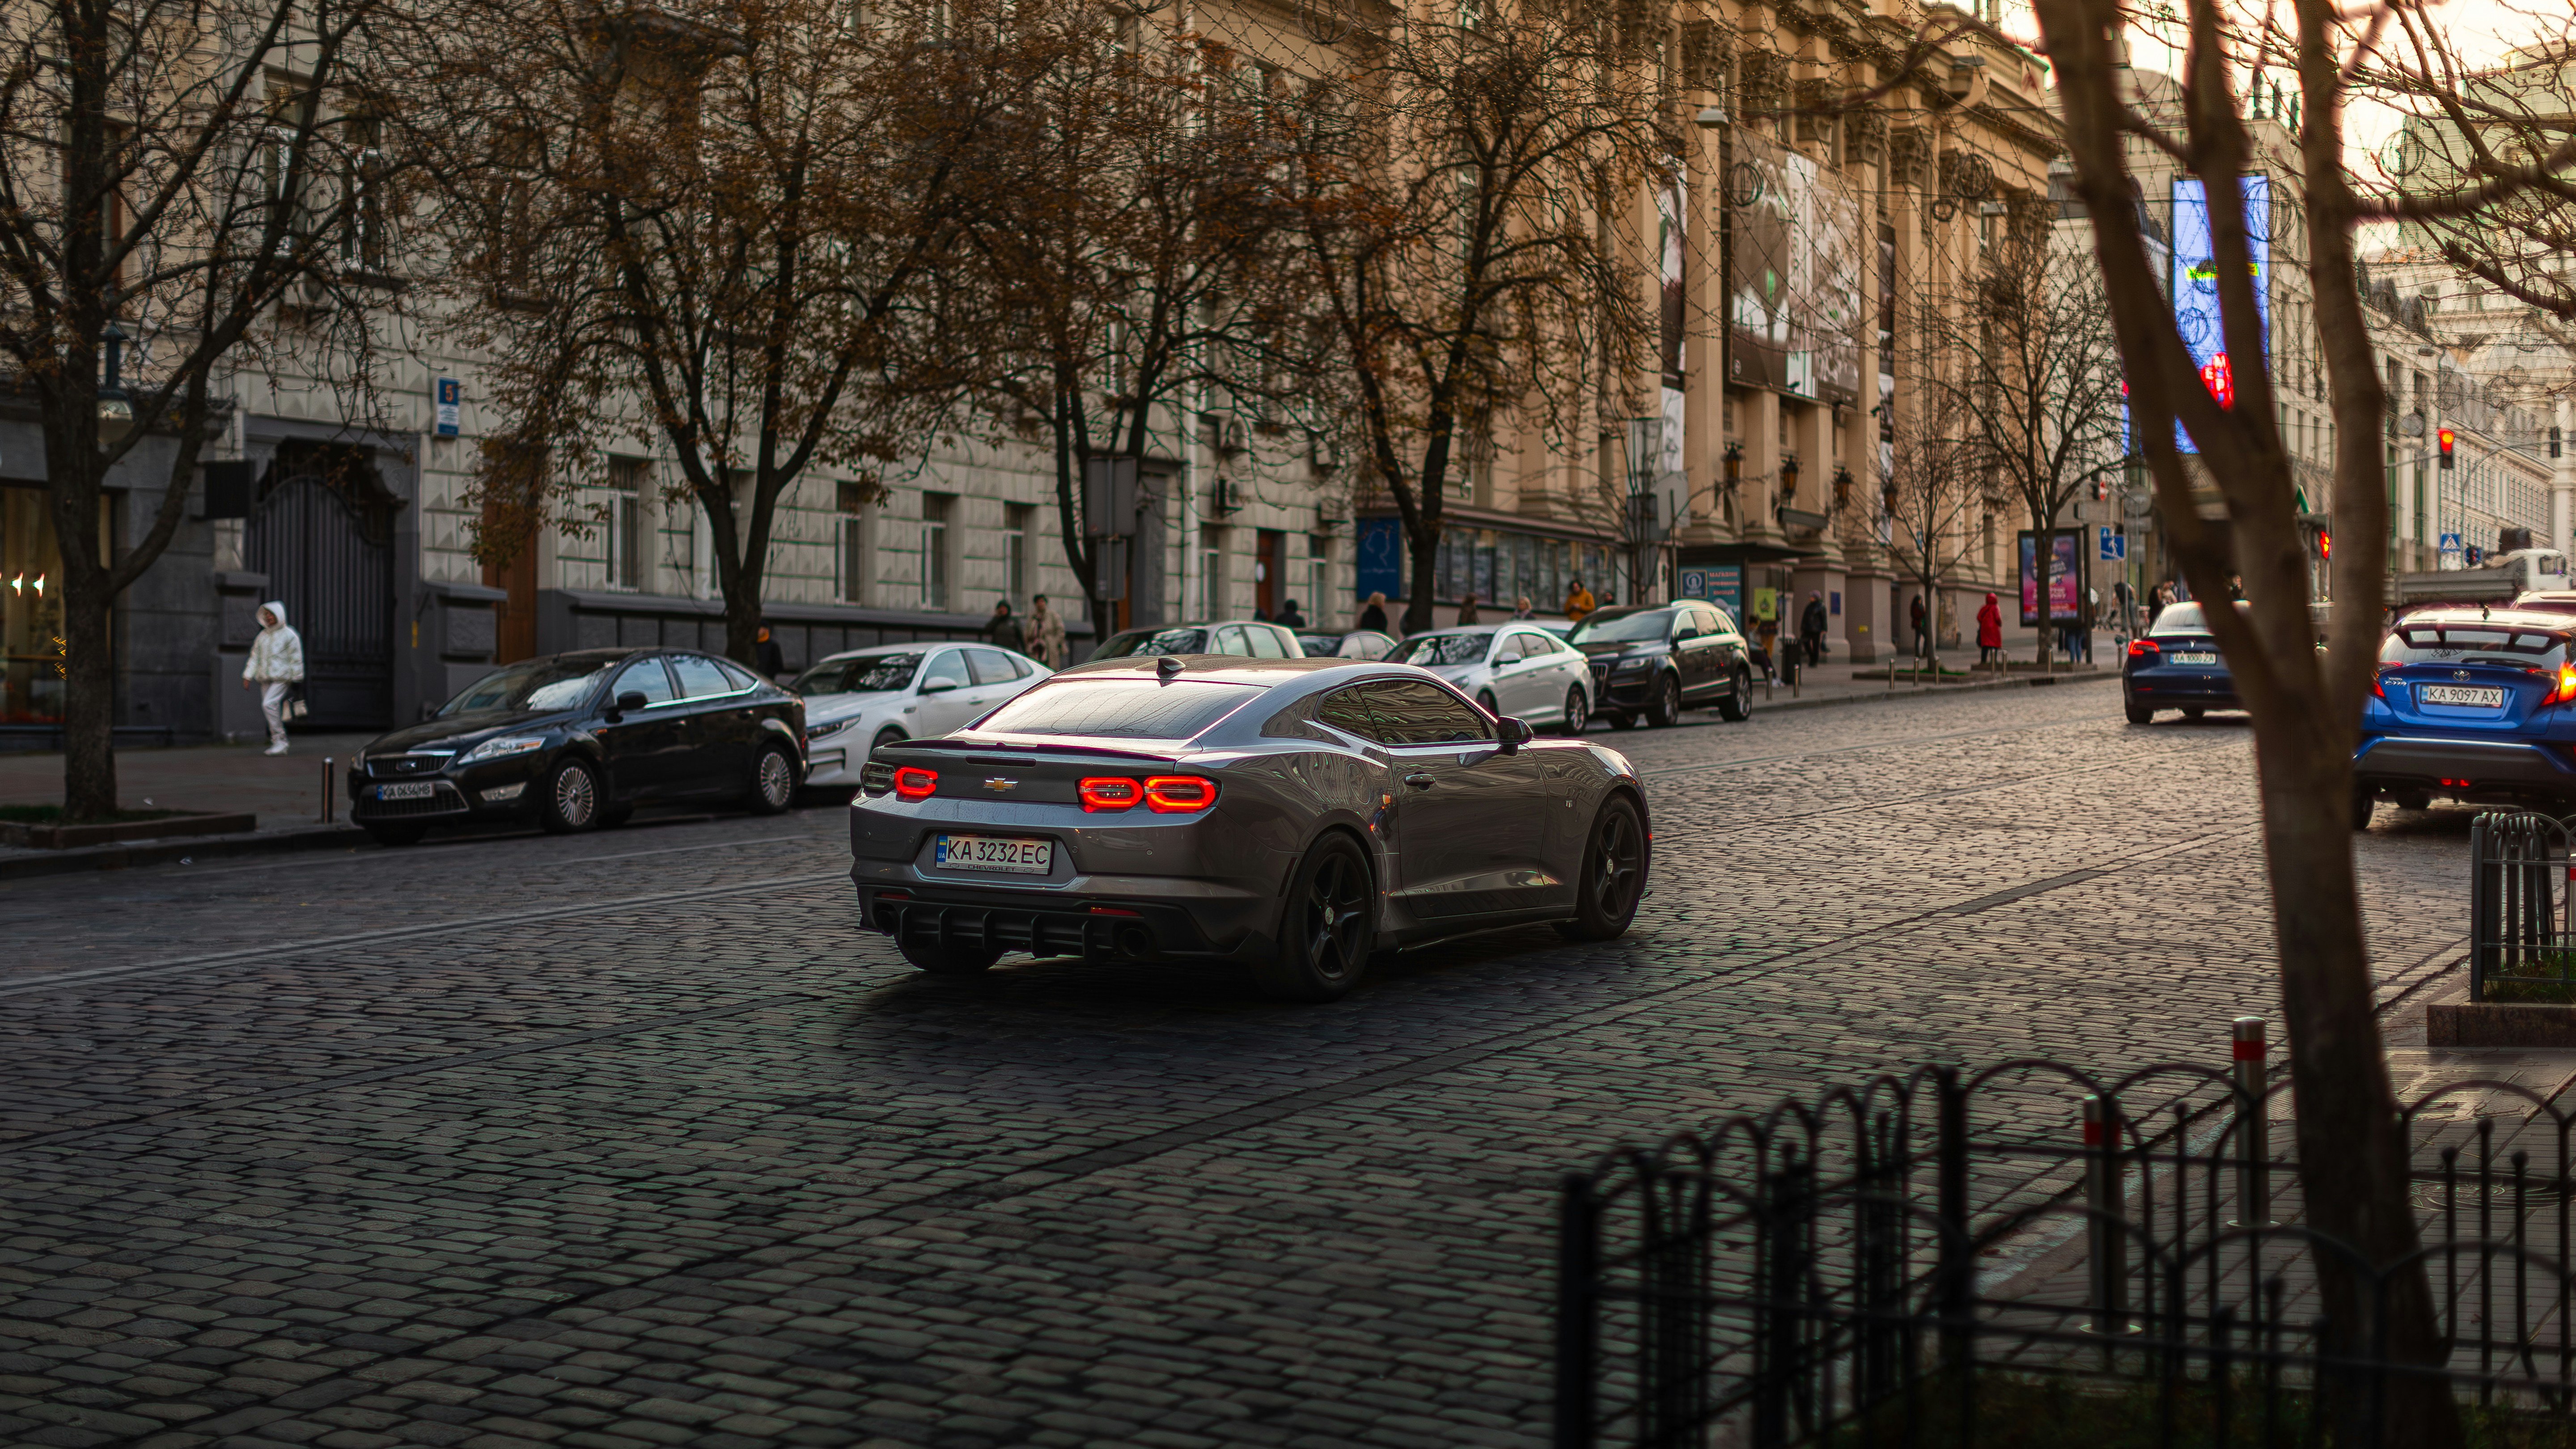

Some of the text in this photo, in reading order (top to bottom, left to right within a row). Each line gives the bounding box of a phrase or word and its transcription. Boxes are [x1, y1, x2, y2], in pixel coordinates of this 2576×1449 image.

[445, 384, 453, 402] 5
[2429, 688, 2500, 703] KA 9097 AX
[947, 839, 1048, 864] KA 3232 EC
[967, 864, 1016, 872] CHEVROLET
